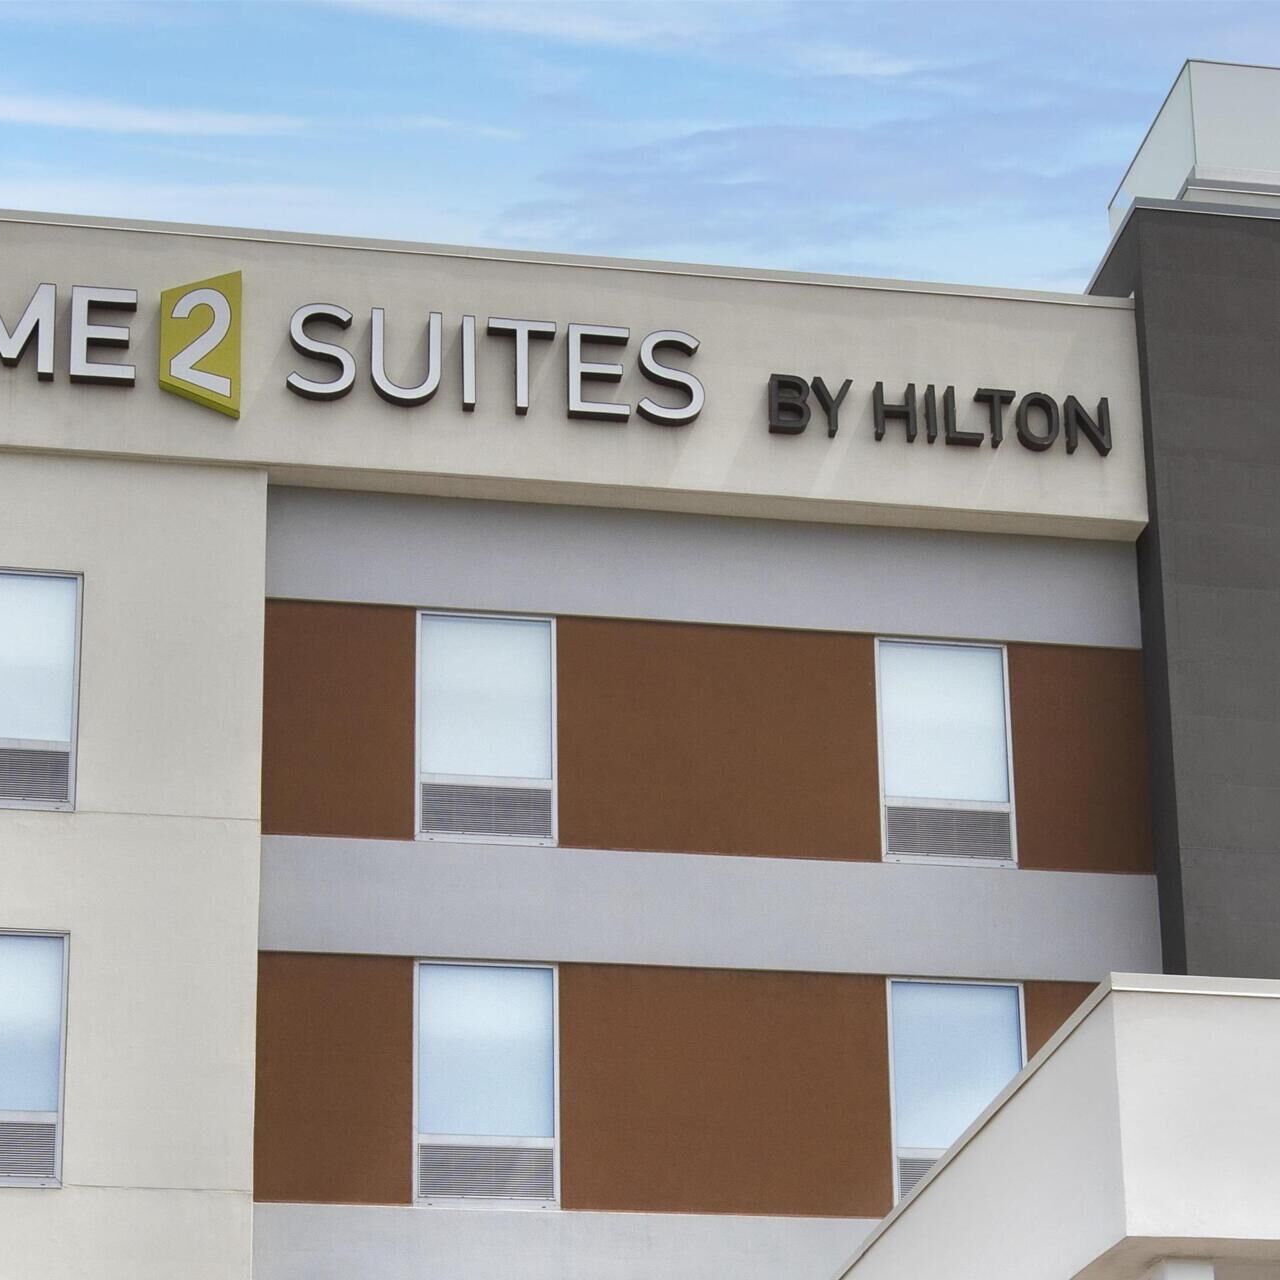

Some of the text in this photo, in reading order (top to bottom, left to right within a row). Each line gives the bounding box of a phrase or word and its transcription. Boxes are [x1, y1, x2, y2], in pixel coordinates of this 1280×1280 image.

[169, 287, 232, 398] 2
[286, 302, 705, 426] SUITES
[768, 373, 853, 438] BY
[873, 381, 1112, 457] HILTON
